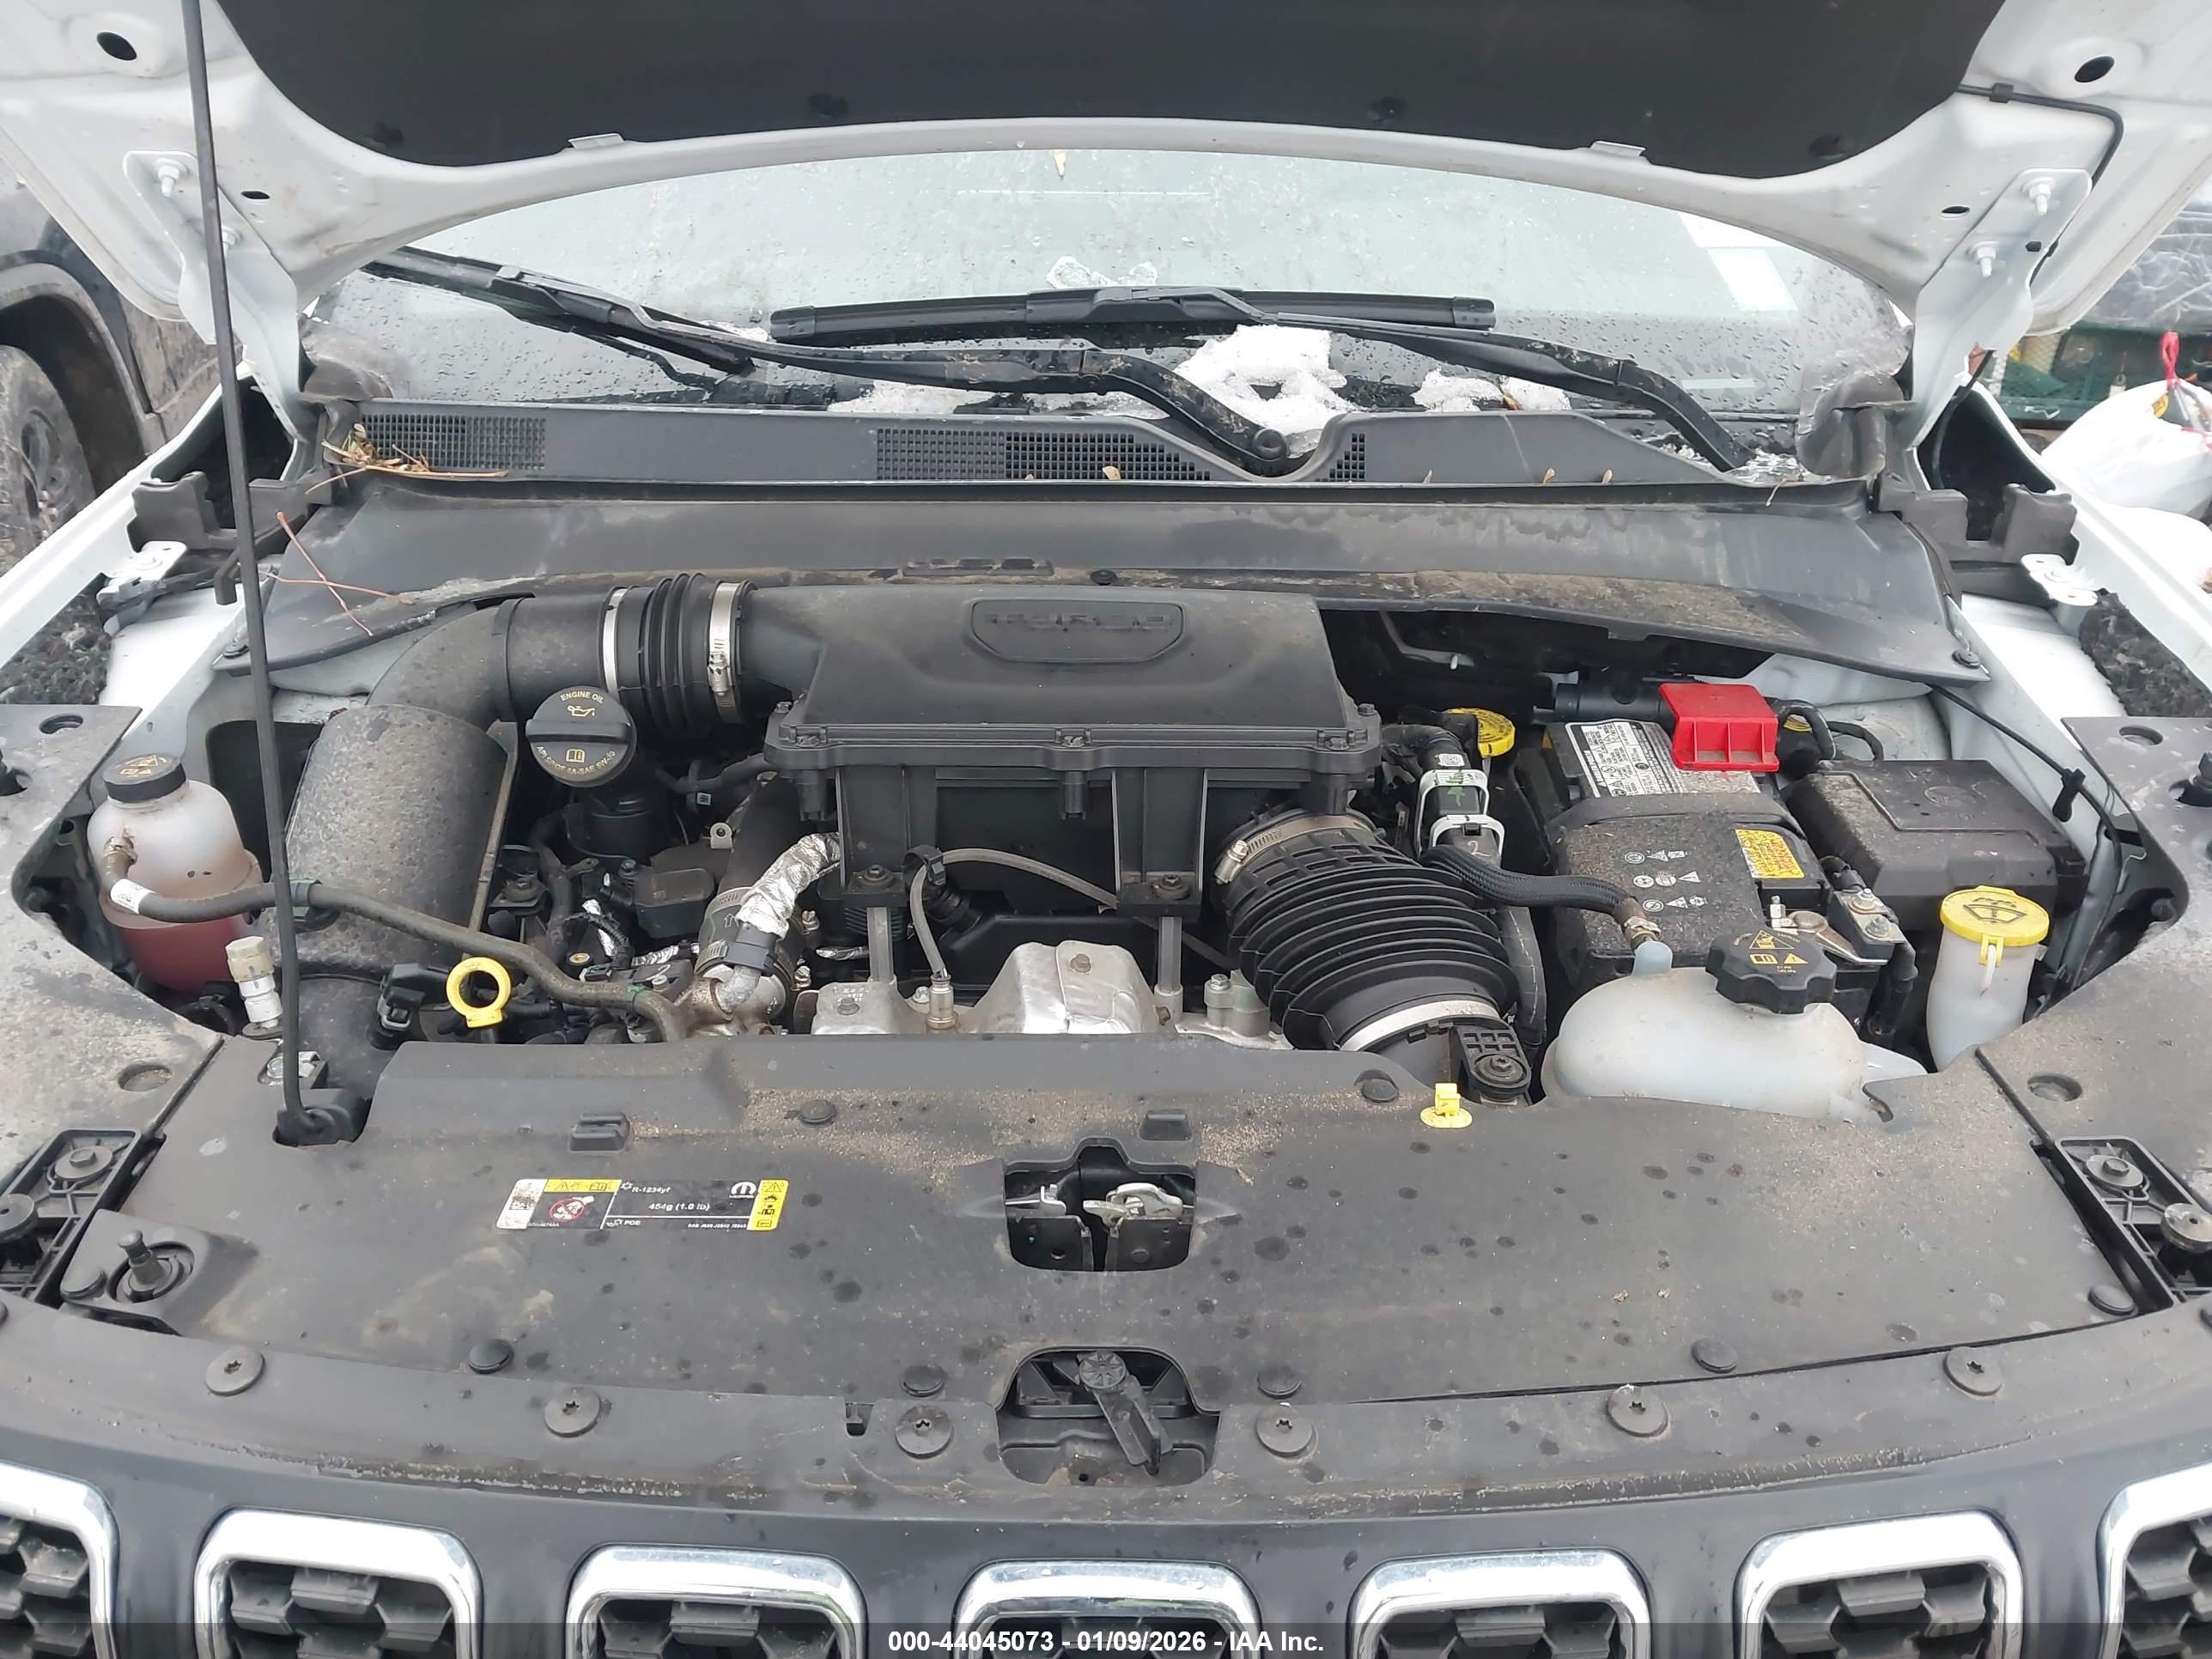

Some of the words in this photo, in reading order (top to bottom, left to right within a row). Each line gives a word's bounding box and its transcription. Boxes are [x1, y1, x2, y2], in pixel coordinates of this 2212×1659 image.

[560, 690, 591, 702] ENGINE
[592, 693, 605, 704] OIL
[648, 1203, 673, 1212] 454g
[675, 1203, 695, 1212] (1.0
